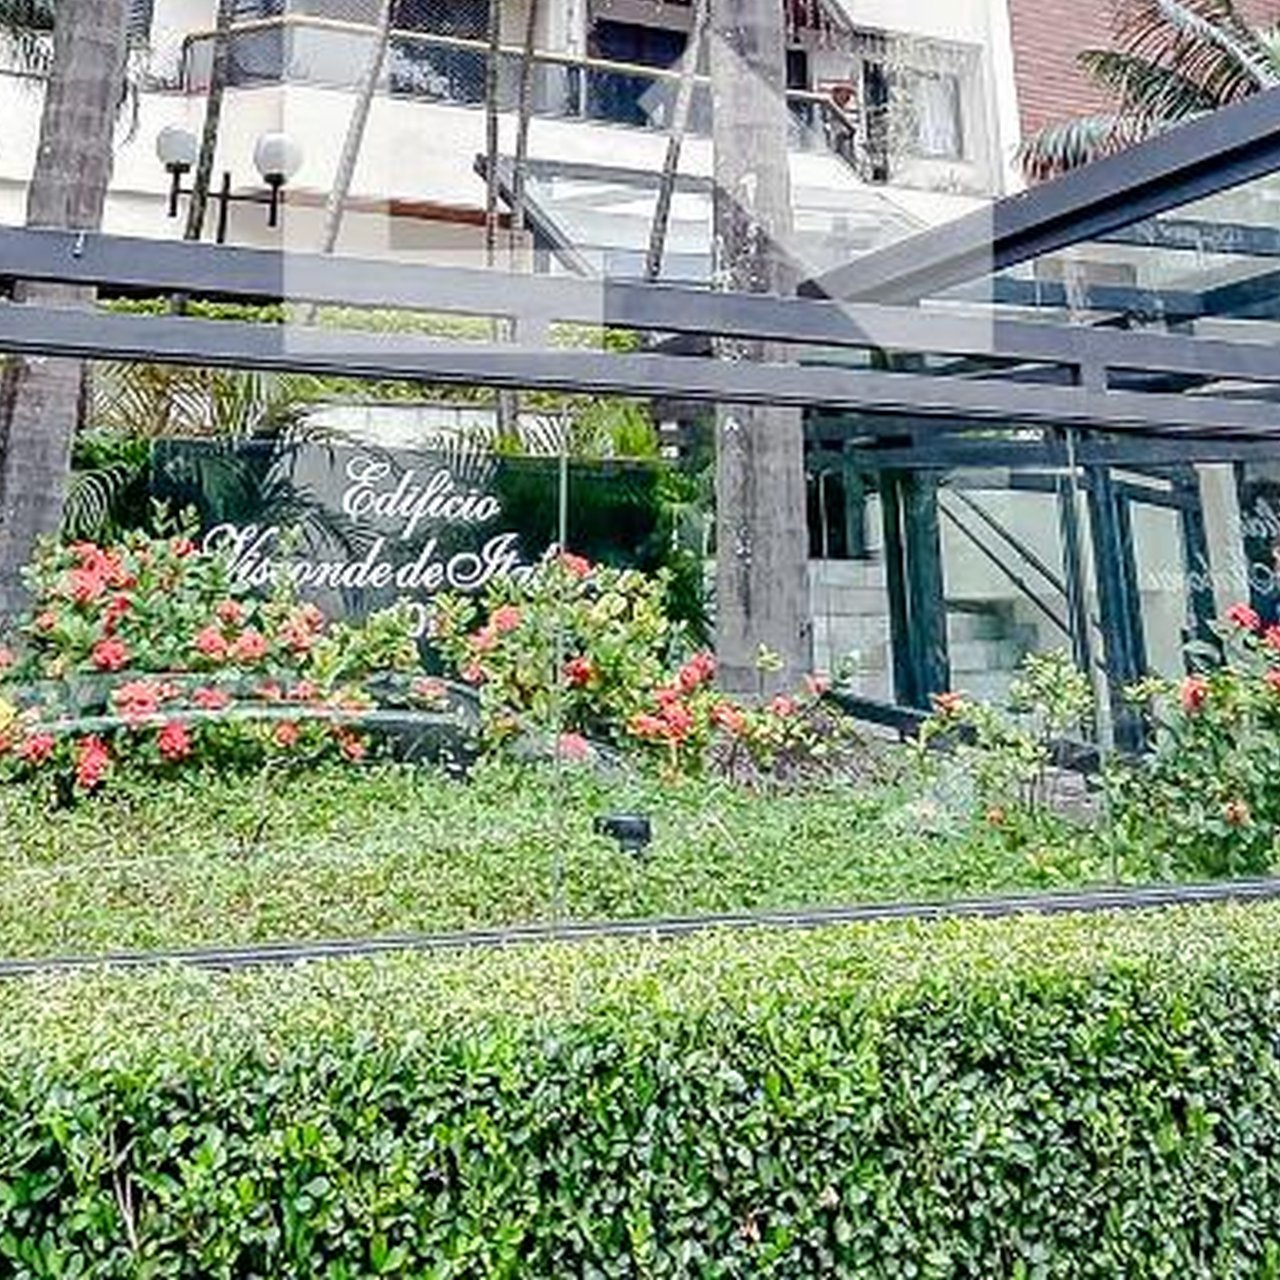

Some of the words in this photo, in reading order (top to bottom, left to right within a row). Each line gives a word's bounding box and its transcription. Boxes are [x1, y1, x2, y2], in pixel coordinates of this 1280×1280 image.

[342, 455, 501, 540] Edifício
[202, 522, 396, 587] Visonde
[396, 537, 444, 587] de
